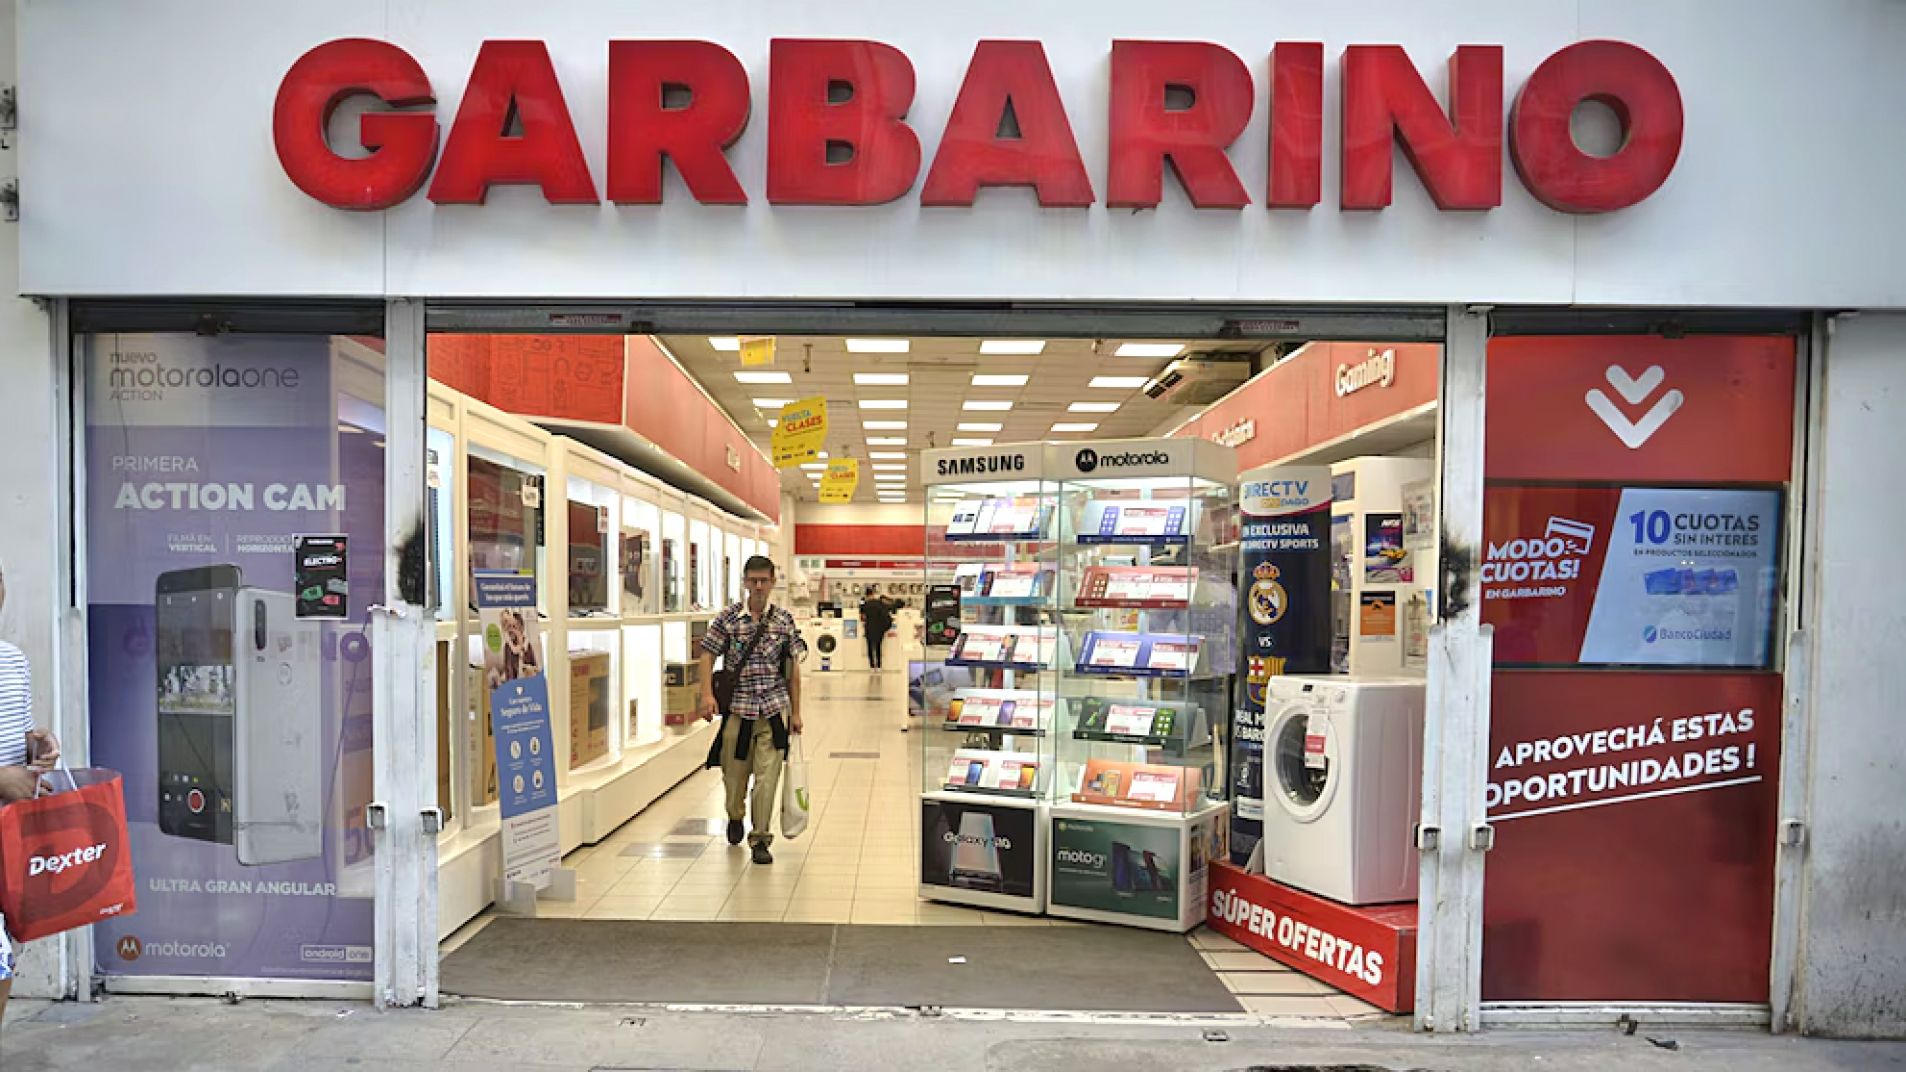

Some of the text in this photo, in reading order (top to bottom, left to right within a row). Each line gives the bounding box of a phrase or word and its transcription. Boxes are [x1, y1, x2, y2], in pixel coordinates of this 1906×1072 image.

[272, 37, 1685, 214] GARBARINO
[109, 352, 156, 364] nuevo
[109, 363, 299, 388] motorolaone
[1335, 348, 1396, 397] Gaming
[109, 390, 163, 401] ACTION
[112, 456, 199, 472] PRIMERA
[937, 454, 1025, 475] SAMSUNG
[1100, 450, 1169, 467] motorola
[114, 483, 346, 511] ACTION CAM
[1629, 510, 1760, 544] 10 CUOTAS
[1673, 533, 1696, 545] SIN
[168, 544, 217, 553] VERTICAL
[238, 544, 294, 553] HORIZONTA
[1487, 538, 1564, 560] MODO
[1480, 559, 1580, 583] CUOTAS!
[1485, 588, 1500, 599] EN
[1258, 637, 1272, 646] VS
[1659, 628, 1732, 640] BancoCiudad
[1495, 709, 1754, 768] APROVECHÁ ESTAS
[1486, 746, 1740, 808] OPORTUNIDADES
[29, 842, 106, 876] Dexter
[150, 878, 335, 896] ULTRA GRAN ANGULAR
[1211, 888, 1384, 986] SÚPER OFERTAS
[145, 942, 226, 958] motorola
[304, 948, 344, 959] android
